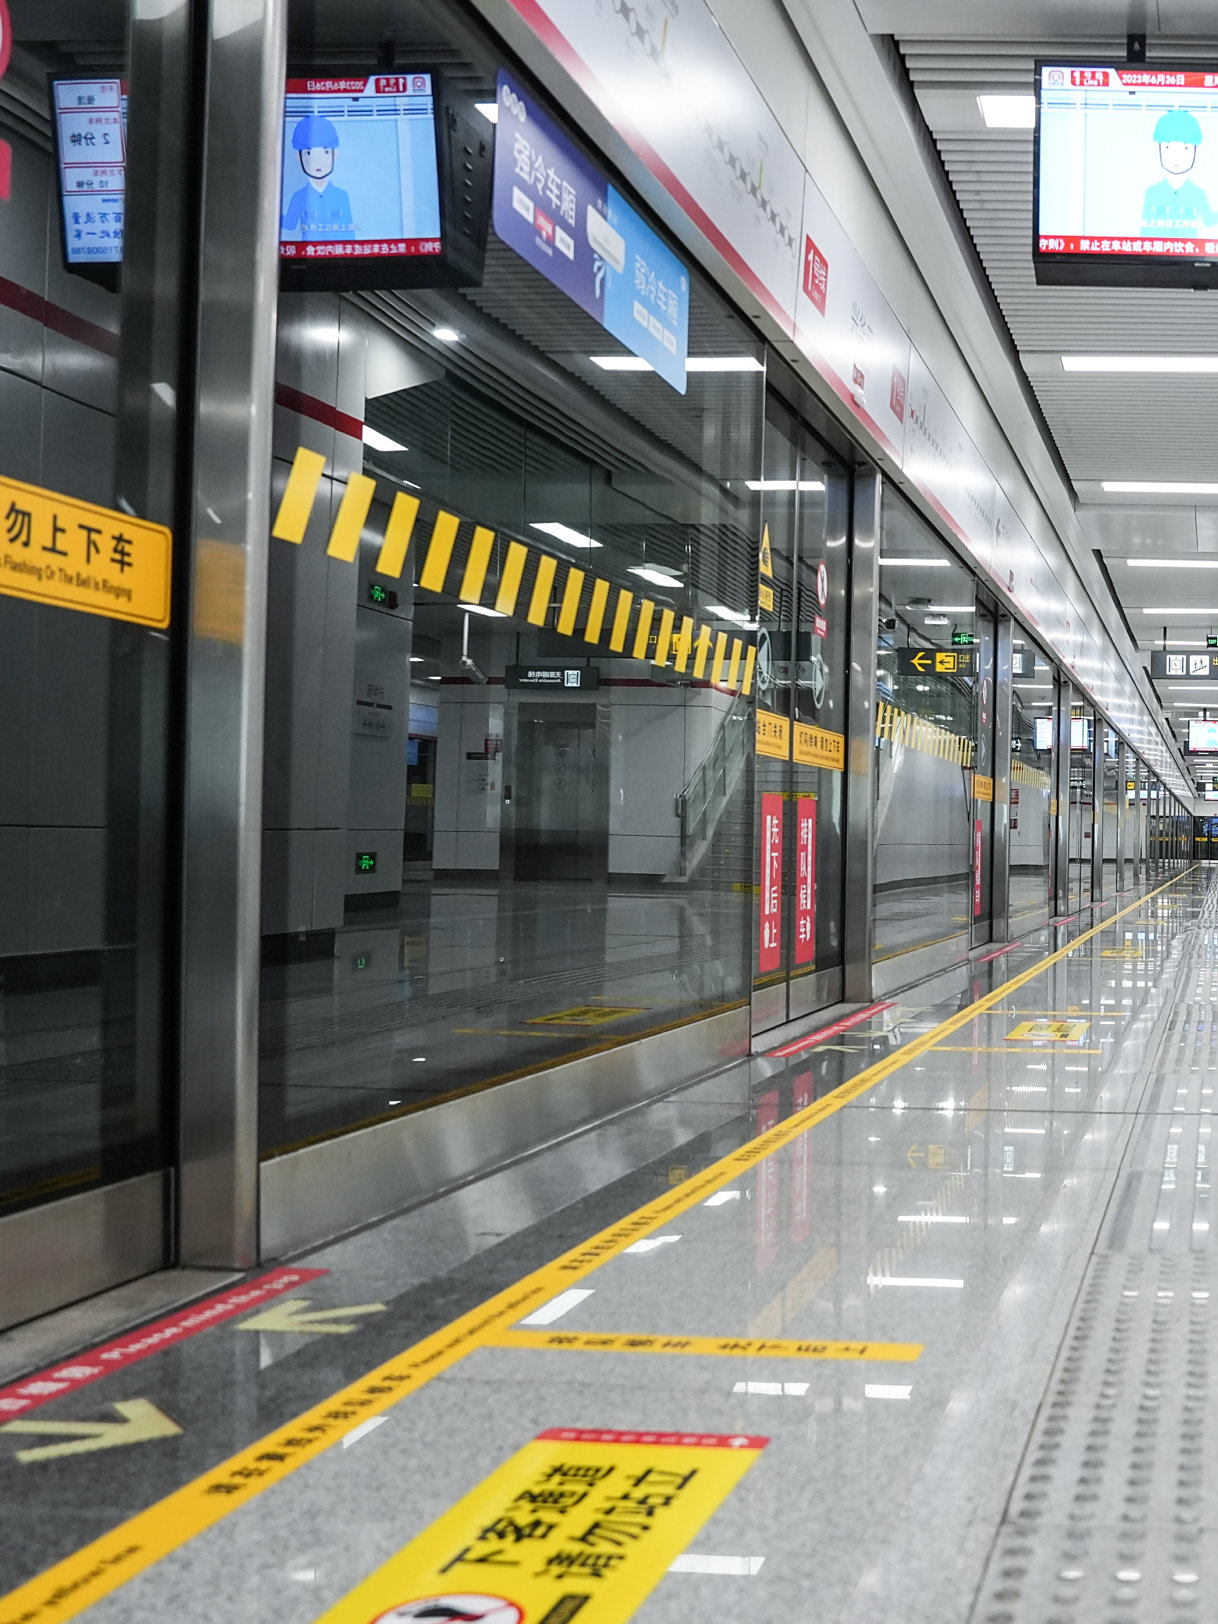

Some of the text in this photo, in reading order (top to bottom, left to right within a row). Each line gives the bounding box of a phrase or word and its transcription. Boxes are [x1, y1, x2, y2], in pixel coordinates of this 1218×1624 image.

[1121, 73, 1185, 87] 2023年6月26日
[513, 131, 577, 228] 强冷车厢
[634, 253, 680, 327] 弱冷车厢
[807, 248, 828, 295] 1号线
[4, 553, 43, 582] Flashing
[45, 564, 56, 580] Or
[57, 567, 74, 585] The
[76, 572, 92, 589] Bell
[102, 578, 133, 603] Ringing
[5, 501, 134, 574] 勿上下车
[770, 815, 779, 948] 先下后上
[799, 818, 808, 944] 排队候车
[438, 1460, 616, 1578] 下客通道
[533, 1465, 700, 1582] 请勿站立
